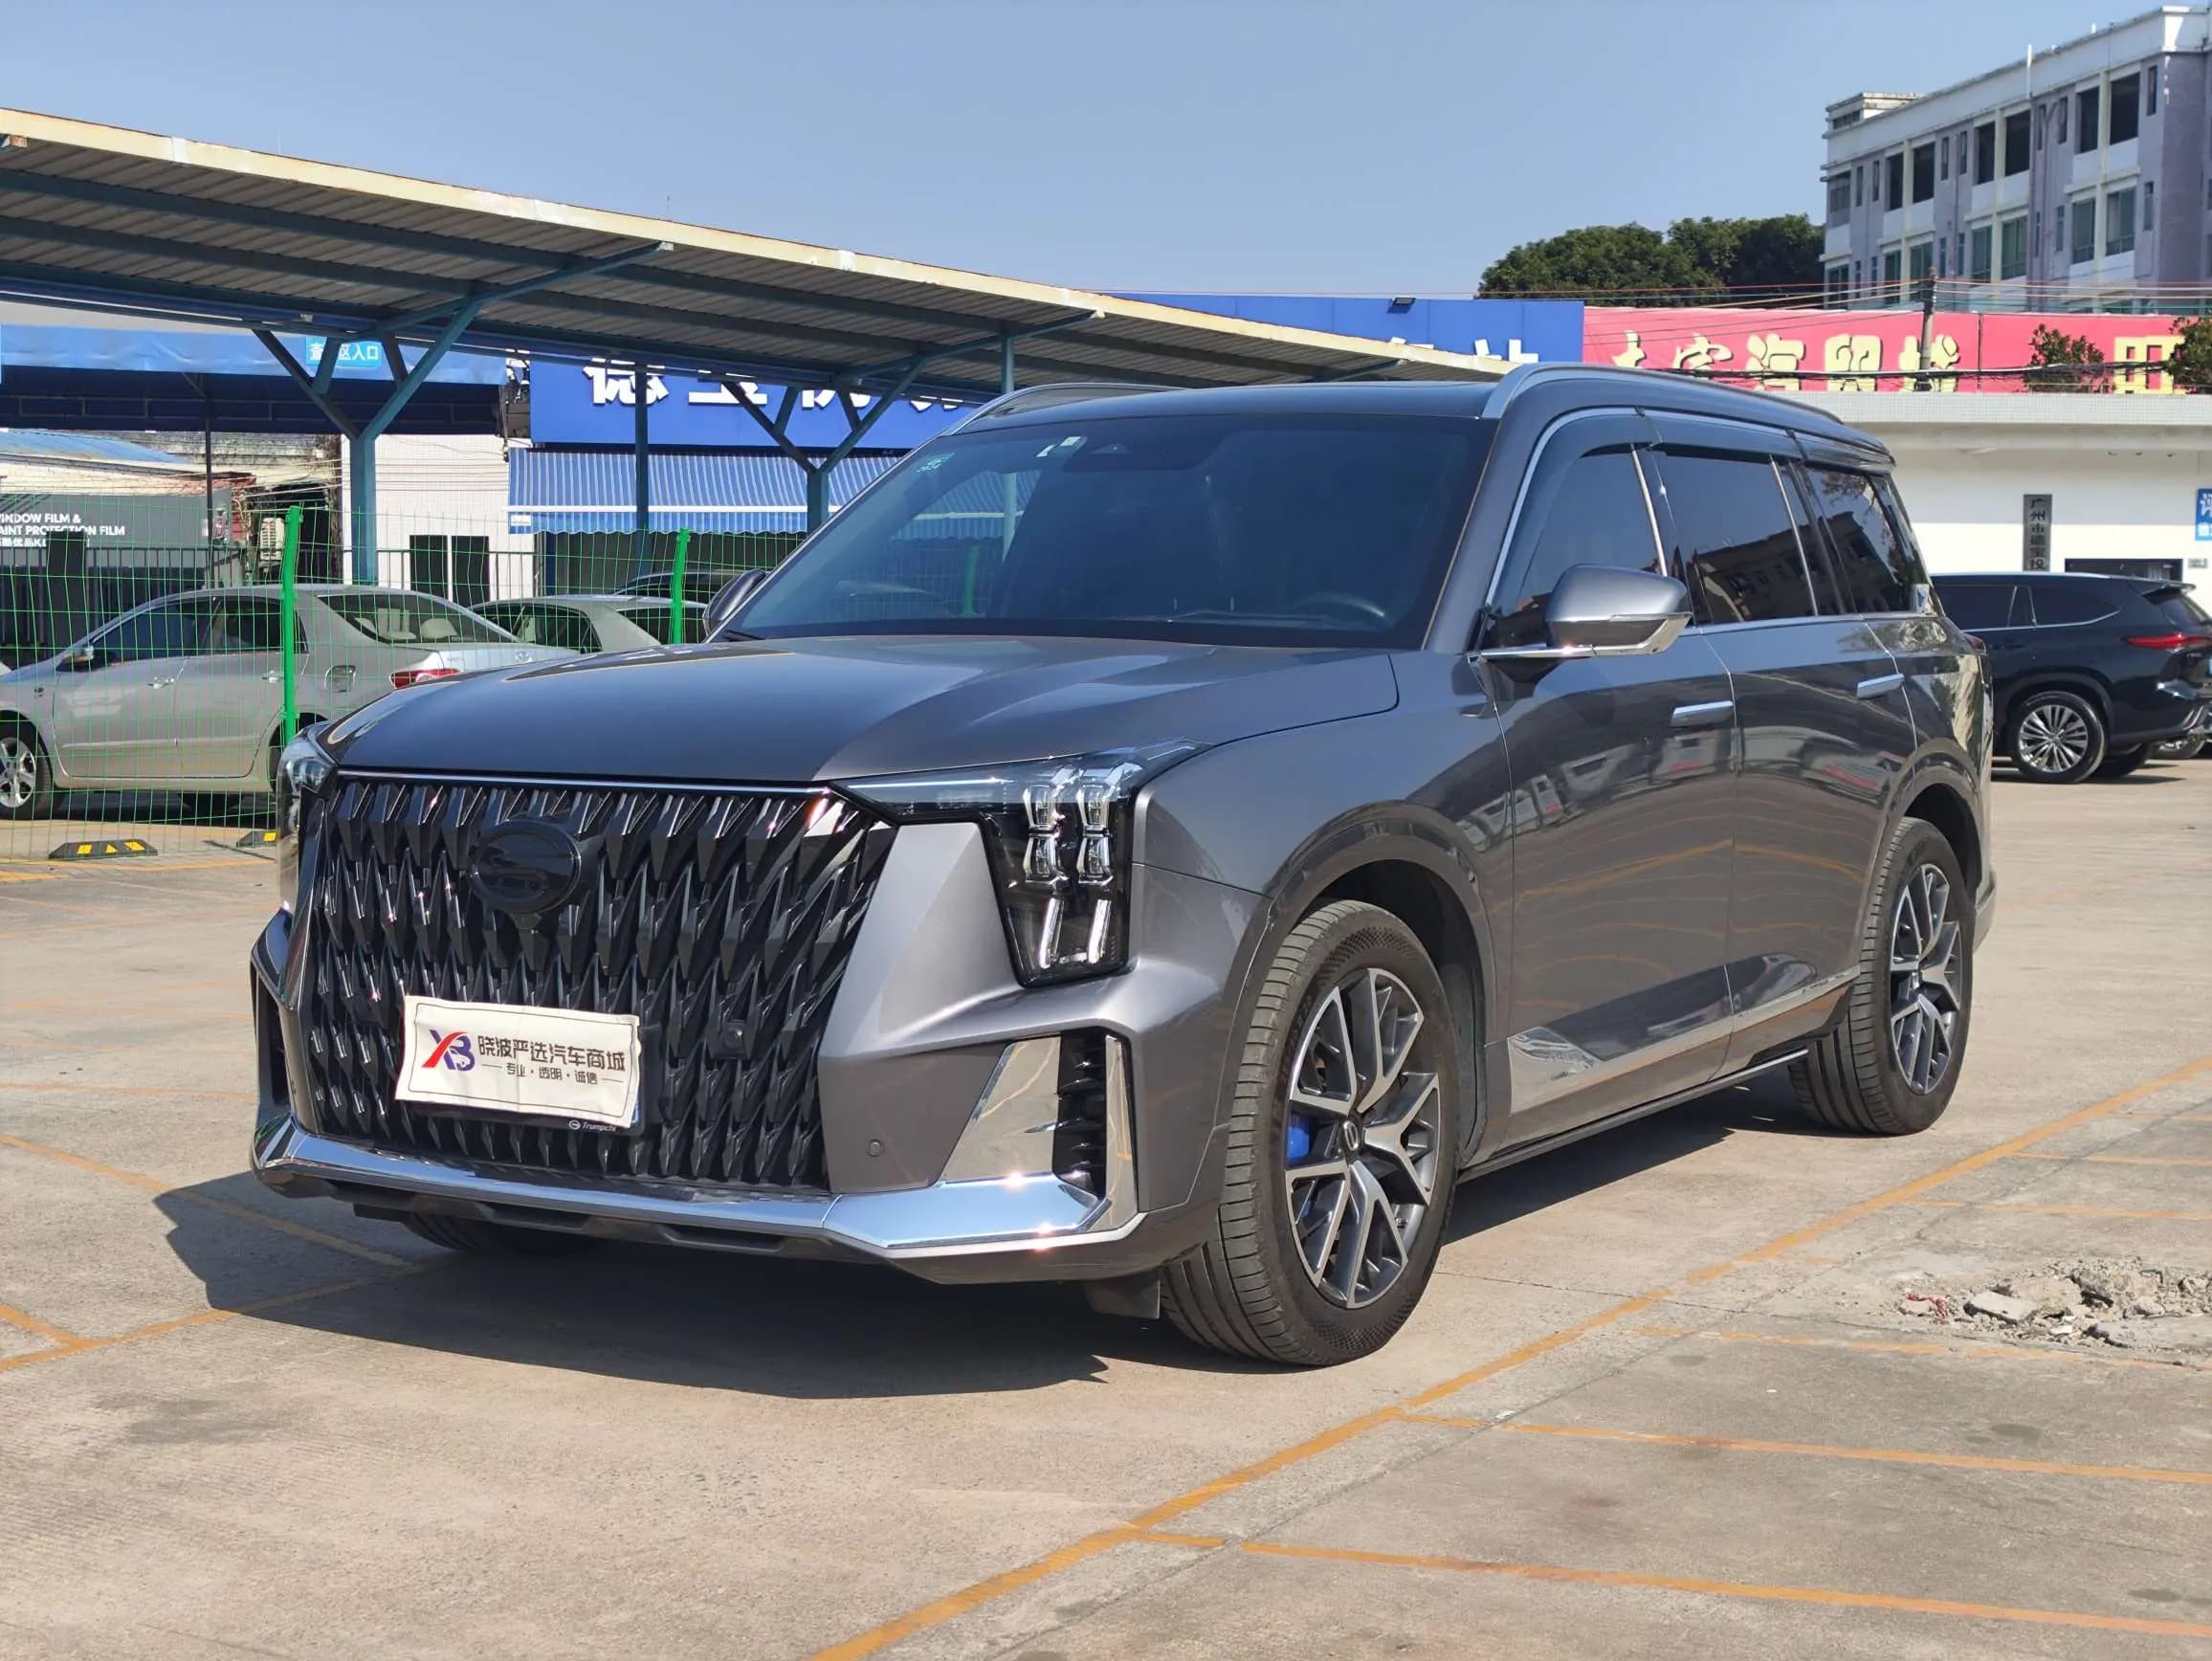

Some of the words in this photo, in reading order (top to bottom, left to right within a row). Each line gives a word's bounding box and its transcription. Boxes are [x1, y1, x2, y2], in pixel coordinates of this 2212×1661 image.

[309, 343, 379, 361] 查区入口
[0, 513, 42, 523] INDOW
[45, 513, 70, 523] FILM
[73, 514, 81, 523] &
[100, 525, 125, 536] FILM
[477, 1035, 626, 1071] 晓波严选汽车商城
[583, 1121, 617, 1132] Trumpchi
